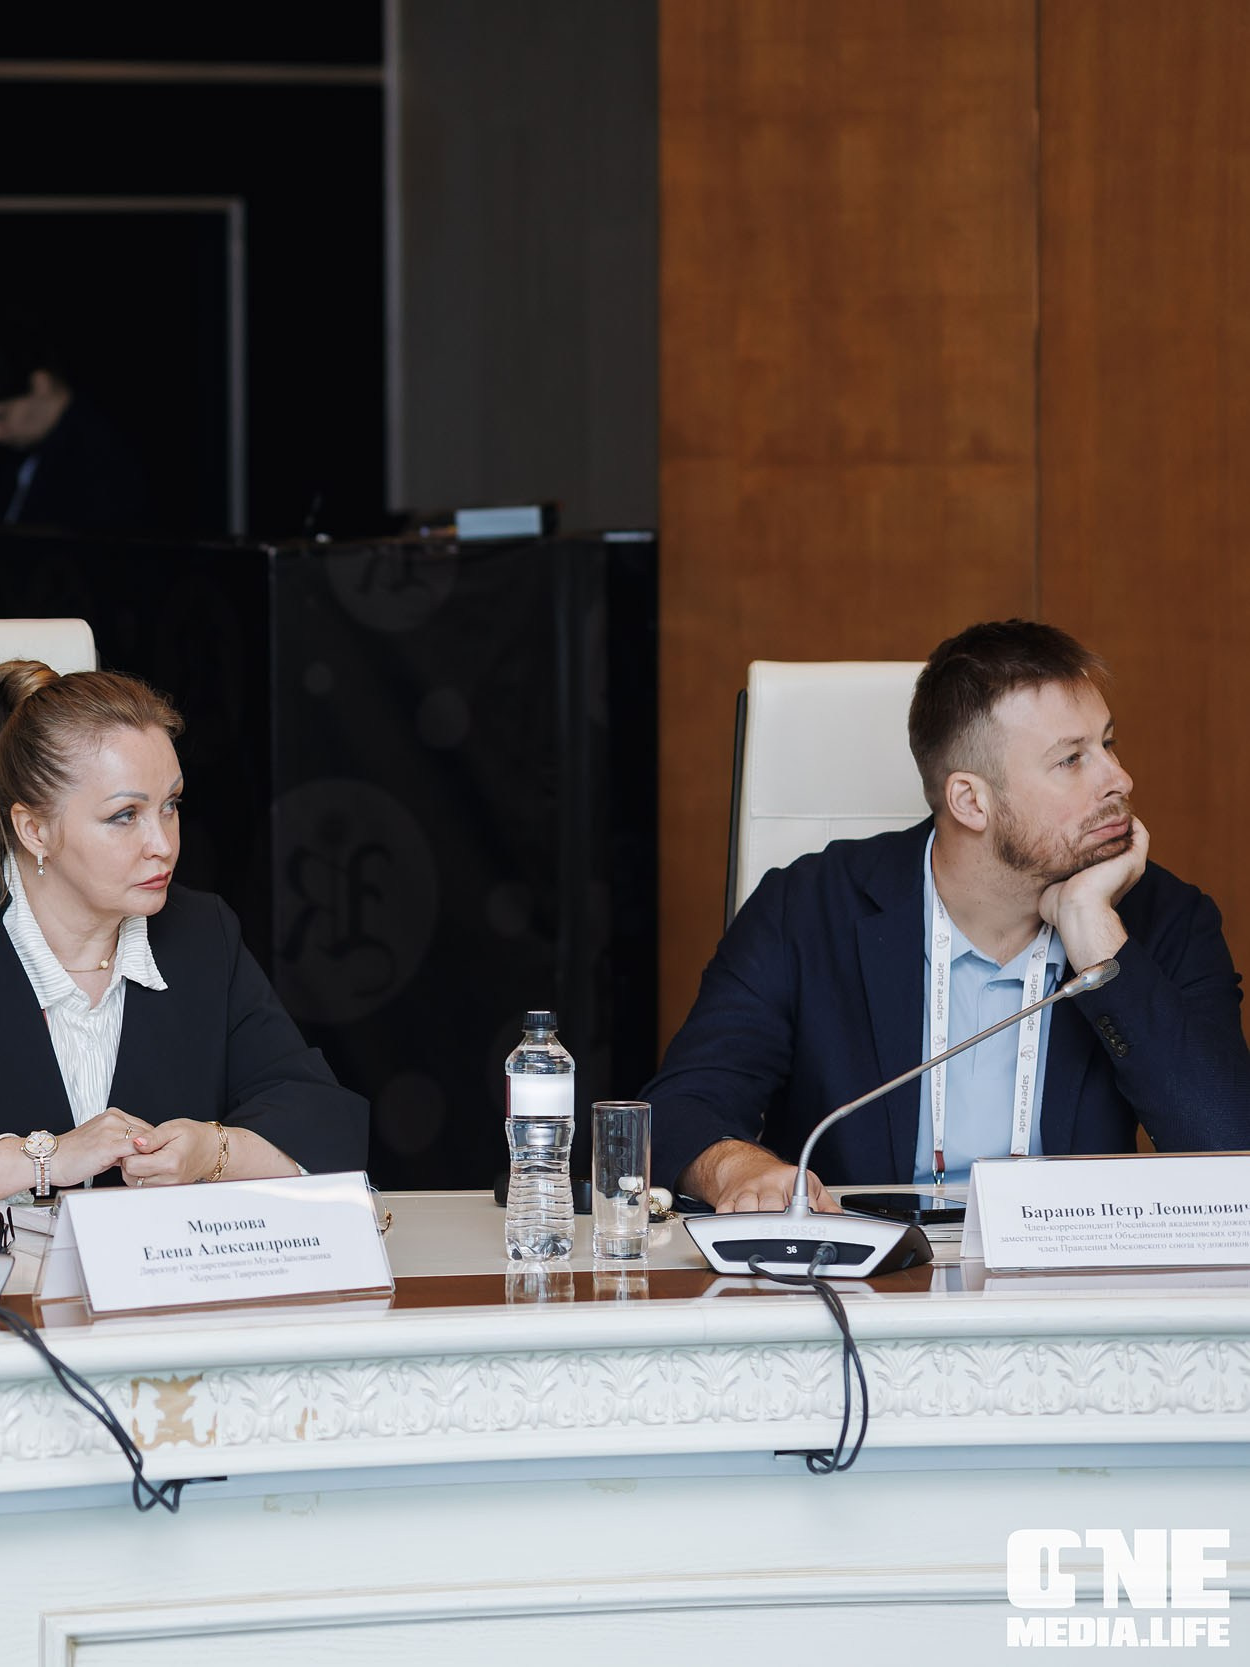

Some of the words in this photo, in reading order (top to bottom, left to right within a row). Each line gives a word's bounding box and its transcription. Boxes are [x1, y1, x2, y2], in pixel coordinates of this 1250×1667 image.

[937, 962, 945, 986] aude
[1021, 1074, 1030, 1106] sapere
[1019, 1108, 1028, 1133] aude
[1021, 1205, 1095, 1221] Баранов
[1101, 1203, 1144, 1219] Петр
[187, 1218, 266, 1236] Морозова
[780, 1225, 827, 1237] BOSCH
[1024, 1222, 1114, 1232] Член-корреспондент
[1116, 1220, 1166, 1230] Российской
[144, 1245, 193, 1261] Елена
[198, 1235, 321, 1257] Александровна
[786, 1246, 797, 1254] 36
[1110, 1242, 1166, 1251] Московского
